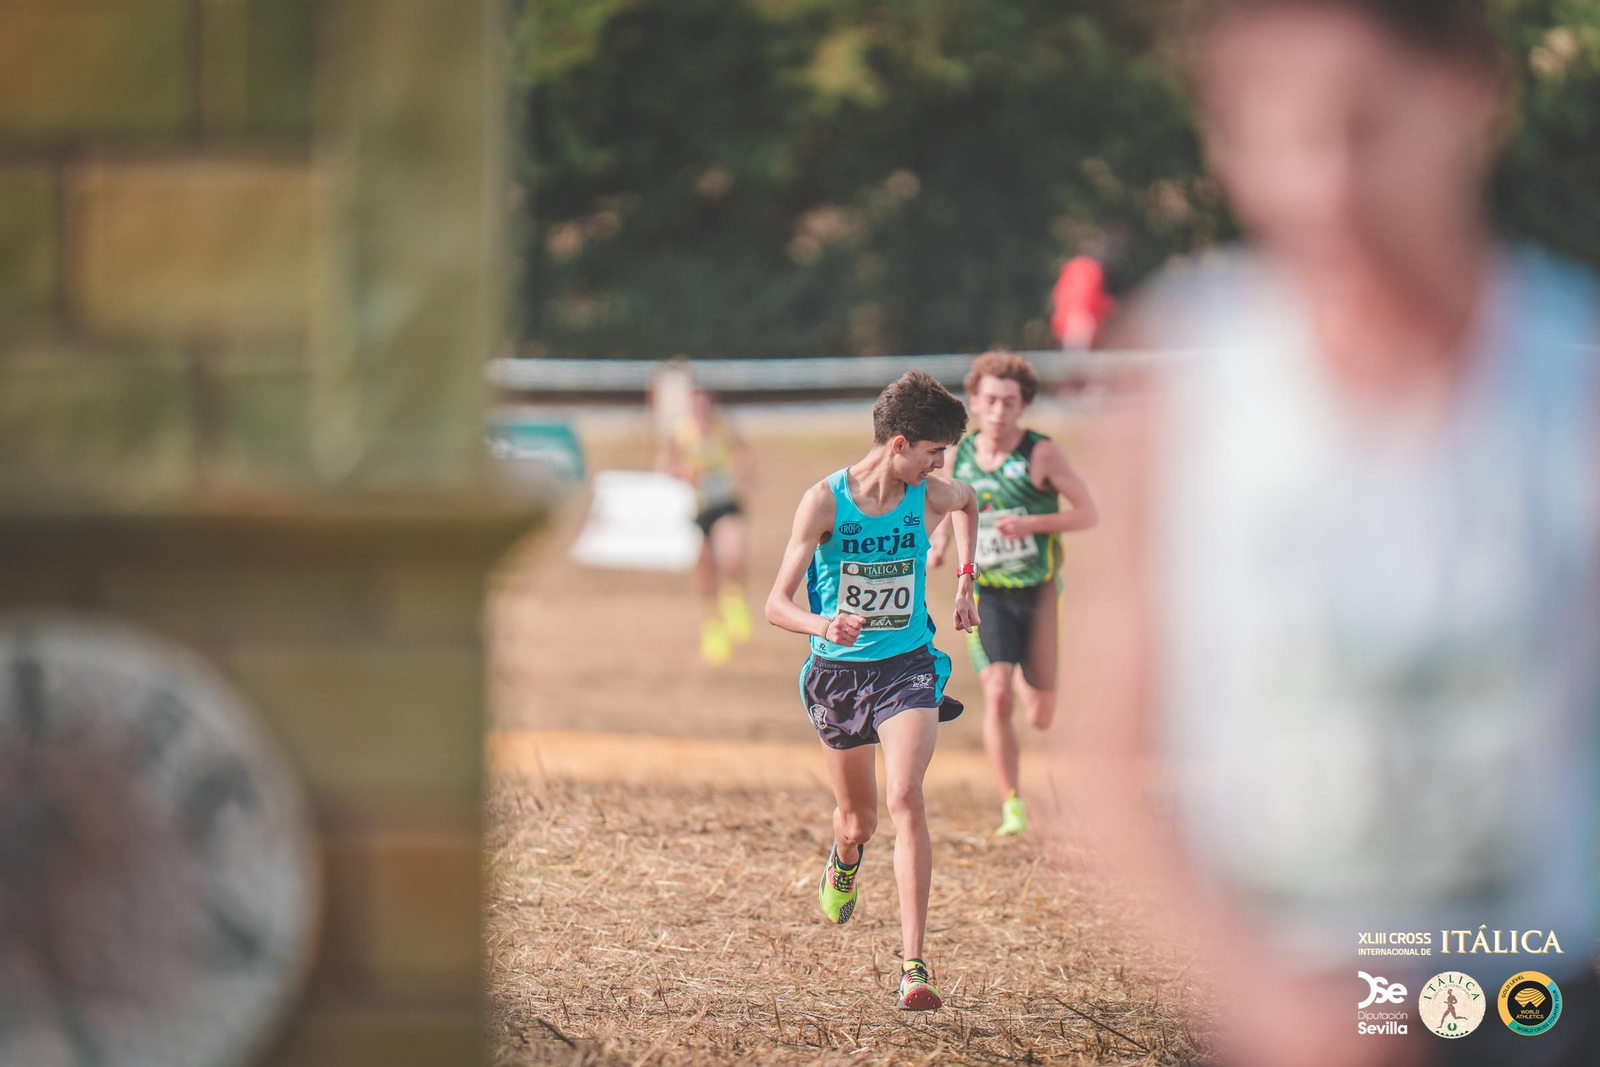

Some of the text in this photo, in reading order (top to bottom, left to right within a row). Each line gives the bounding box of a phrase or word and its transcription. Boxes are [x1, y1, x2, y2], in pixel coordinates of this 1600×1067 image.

[841, 528, 916, 555] nerja
[863, 564, 898, 575] ITÁLICA
[845, 585, 910, 611] 8270
